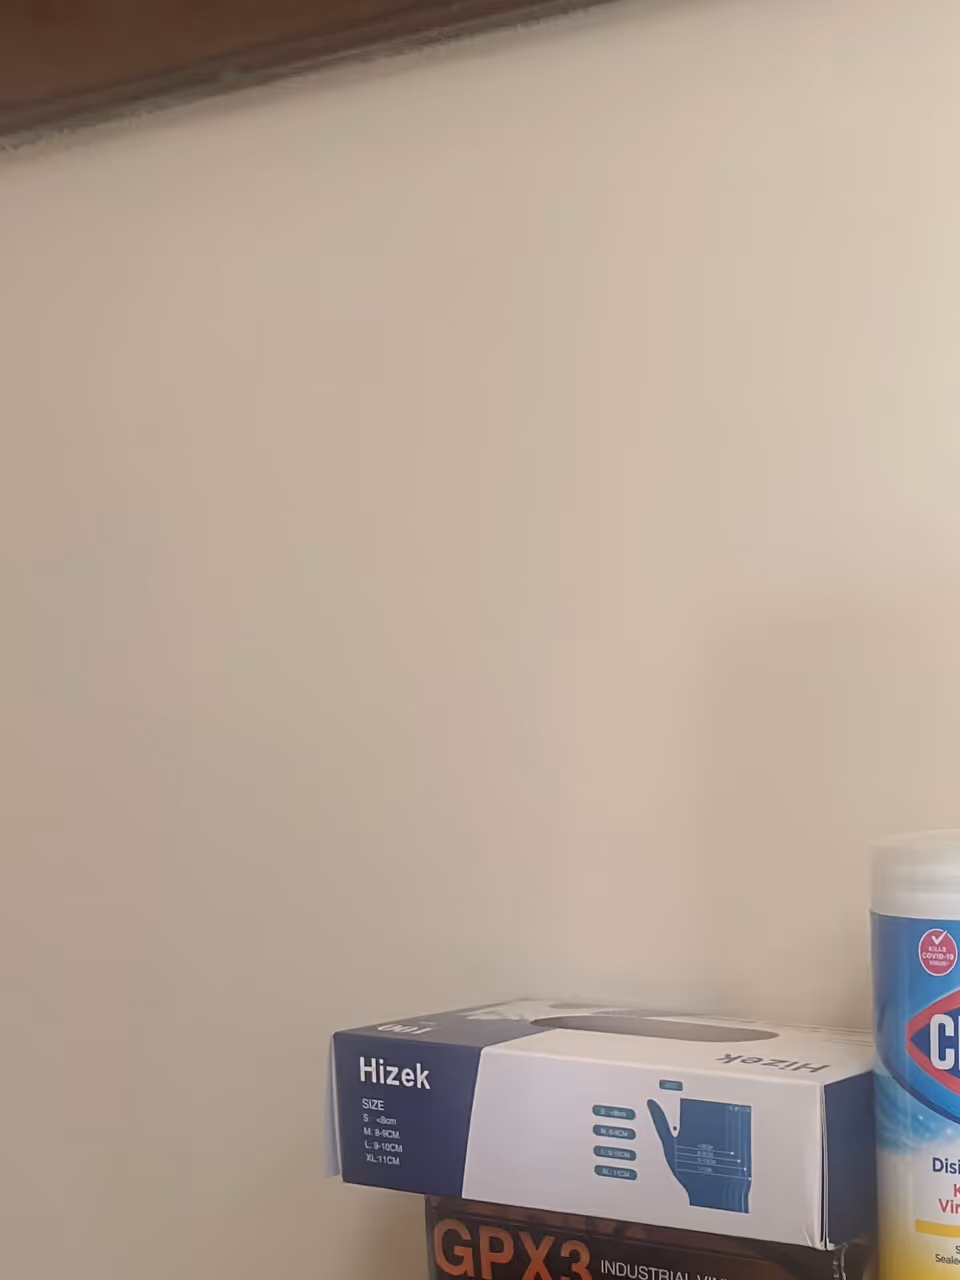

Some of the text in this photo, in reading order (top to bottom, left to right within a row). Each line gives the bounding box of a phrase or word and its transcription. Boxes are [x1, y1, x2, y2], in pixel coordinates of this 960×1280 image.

[922, 952, 954, 960] COVID-19
[715, 1053, 831, 1074] Hizek
[359, 1056, 432, 1090] Hizek
[361, 1098, 385, 1110] SIZE
